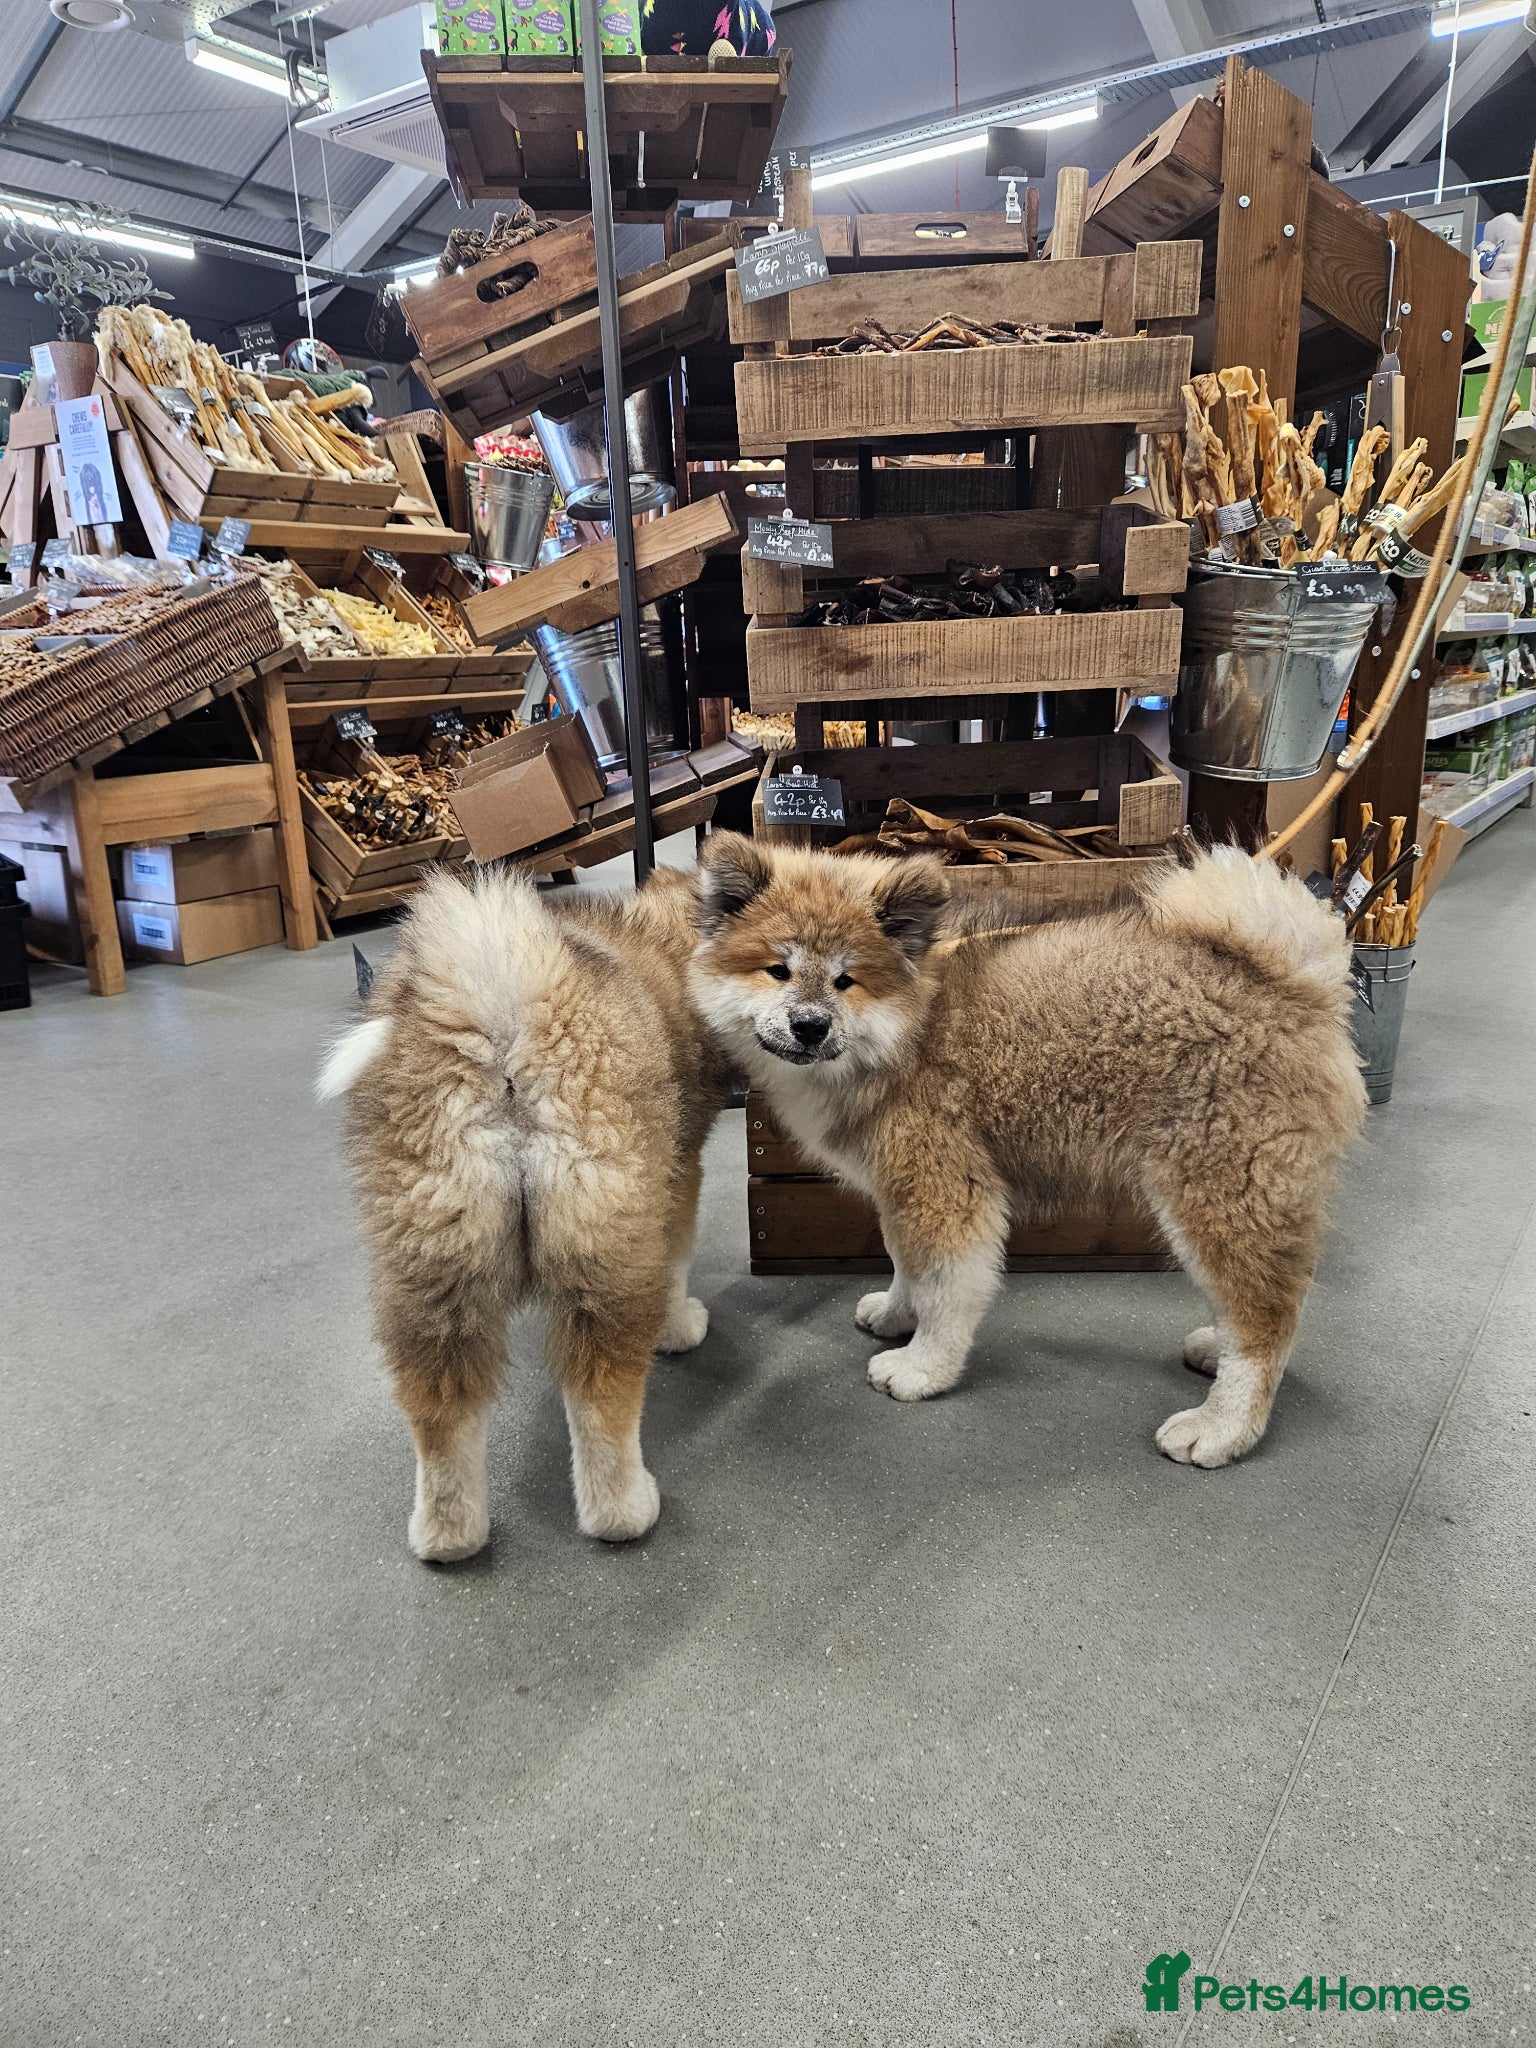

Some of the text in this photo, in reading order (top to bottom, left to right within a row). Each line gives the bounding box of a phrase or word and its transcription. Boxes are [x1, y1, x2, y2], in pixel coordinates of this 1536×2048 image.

[755, 258, 780, 276] 66p
[71, 411, 87, 424] CHEWS
[1306, 578, 1367, 598] £3.49
[773, 792, 806, 808] 42p
[811, 805, 844, 821] £3.49
